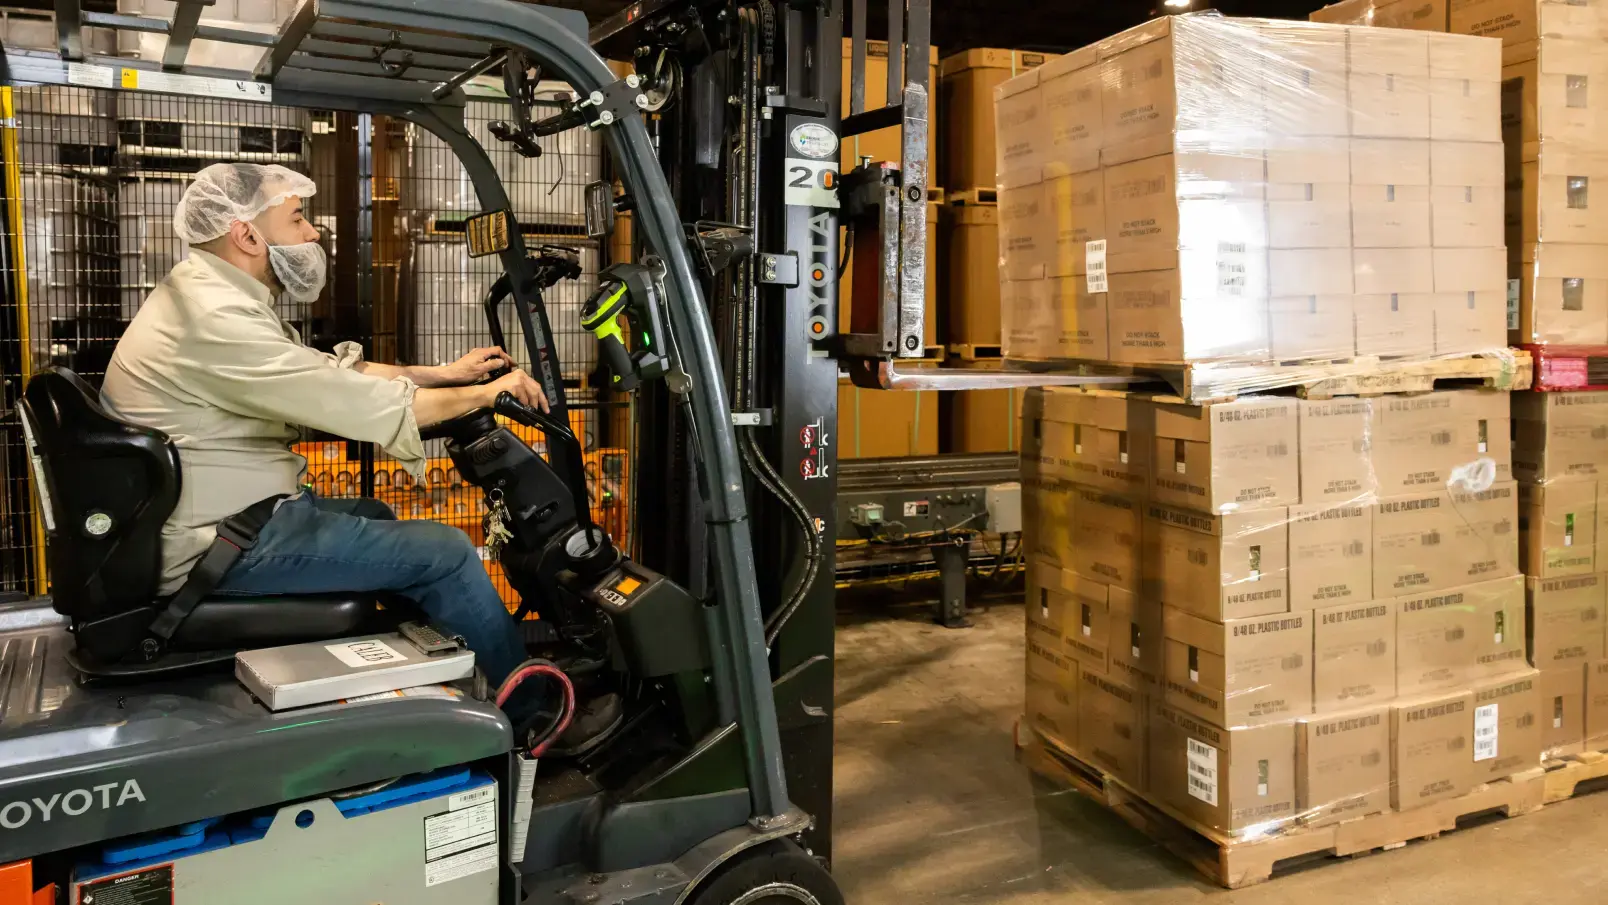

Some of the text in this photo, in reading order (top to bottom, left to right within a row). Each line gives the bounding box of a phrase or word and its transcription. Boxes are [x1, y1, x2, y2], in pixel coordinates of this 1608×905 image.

[807, 211, 830, 365] TOYOTA
[1344, 608, 1364, 621] PLASTIC
[1366, 605, 1386, 618] BOTTLES
[1257, 620, 1279, 633] PLASTIC
[1280, 617, 1302, 630] BOTTLES
[347, 642, 394, 661] CALEB
[115, 874, 140, 884] DANGER
